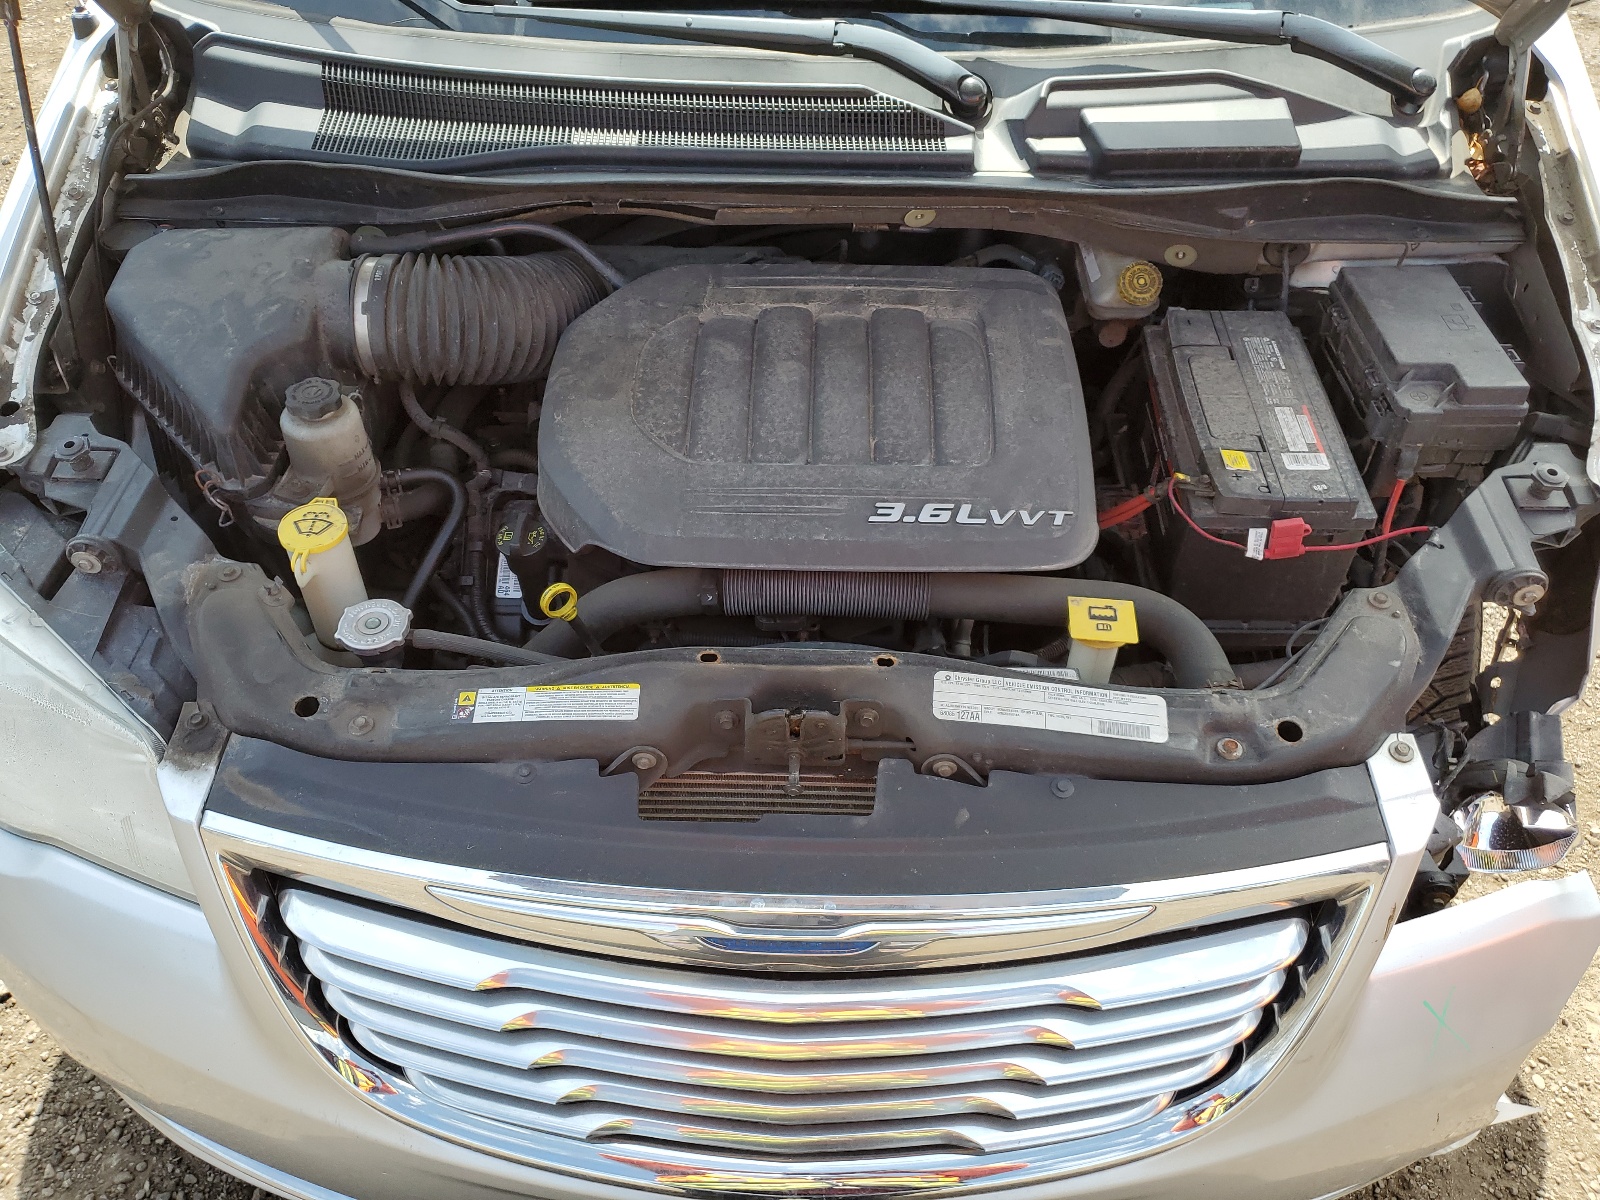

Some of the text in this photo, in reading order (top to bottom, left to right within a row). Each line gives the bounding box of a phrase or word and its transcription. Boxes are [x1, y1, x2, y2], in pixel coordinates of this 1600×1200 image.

[868, 502, 1074, 526] 3.6L VVT
[1026, 683, 1050, 692] EMISSION
[1074, 689, 1108, 698] INFORMATION
[956, 711, 980, 720] 127AA
